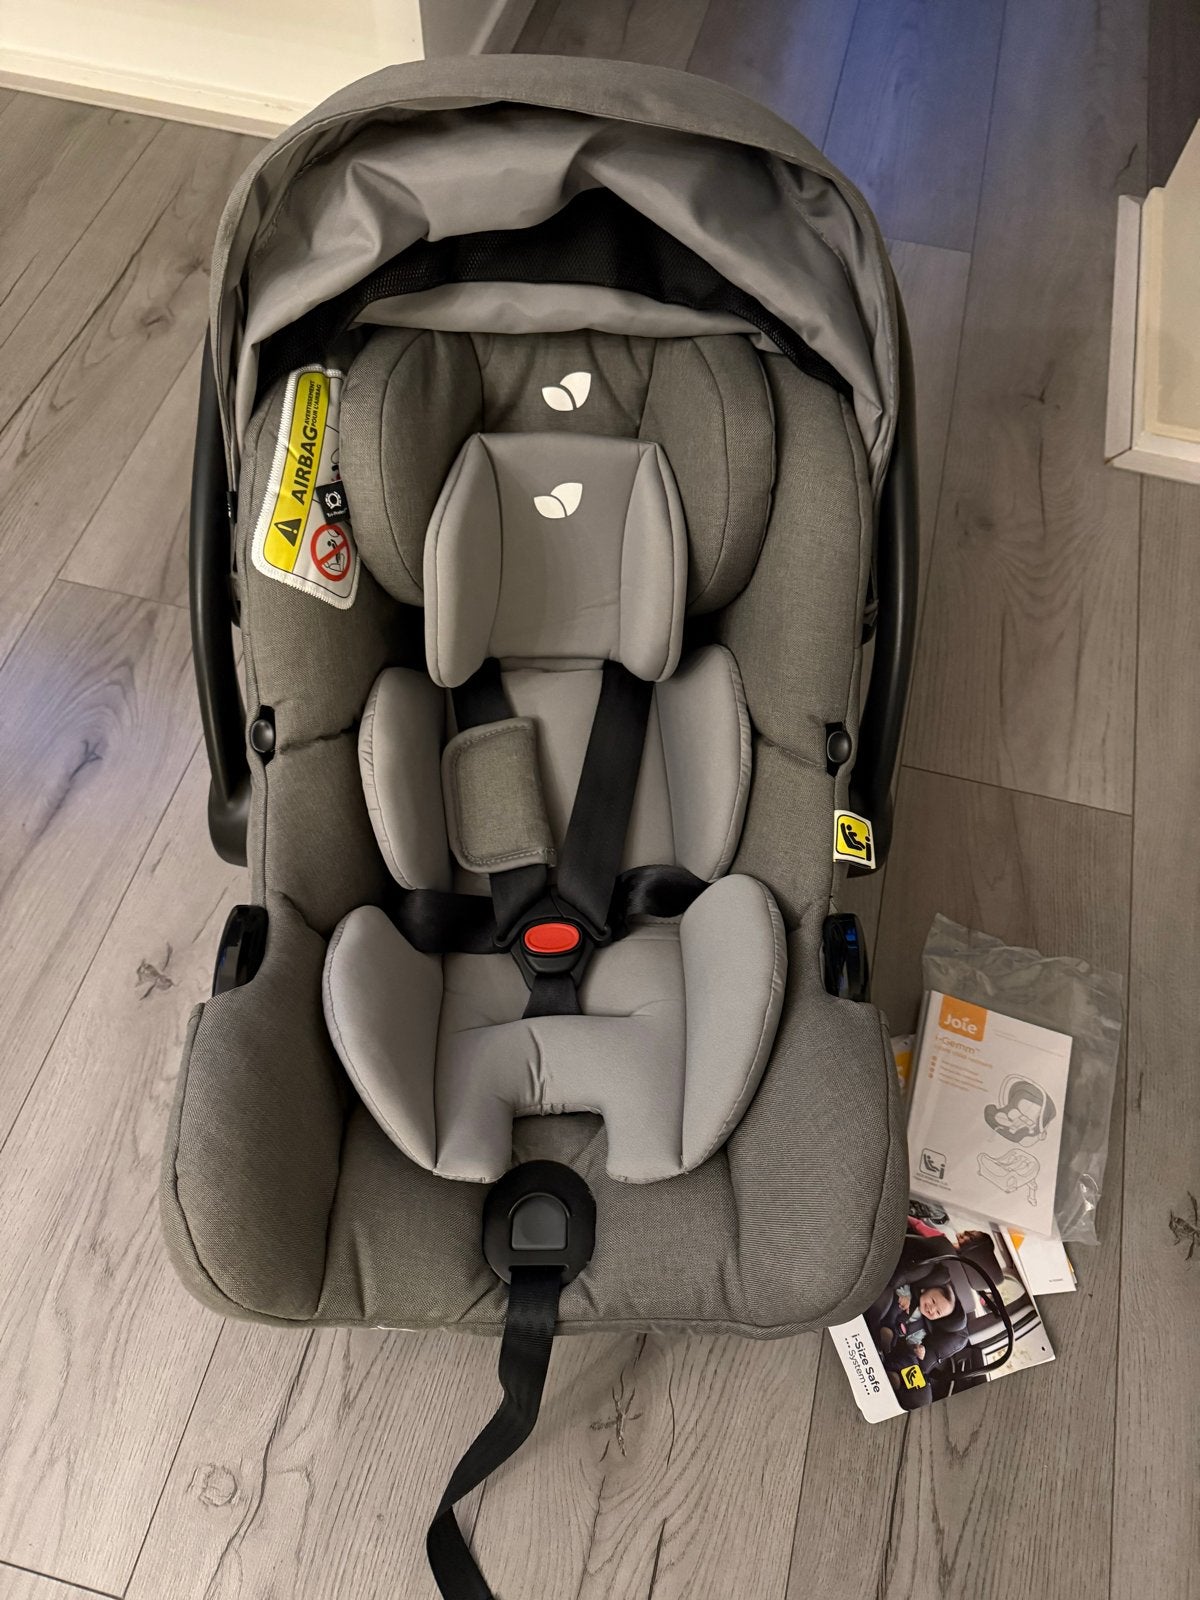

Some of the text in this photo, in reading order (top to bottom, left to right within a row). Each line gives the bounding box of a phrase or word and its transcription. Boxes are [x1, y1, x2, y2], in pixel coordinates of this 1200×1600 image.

[304, 380, 315, 426] AVERTISSEMENT
[291, 425, 318, 506] AIRBAG
[943, 1014, 978, 1034] Joie
[848, 1349, 866, 1384] System
[851, 1333, 880, 1393] i-Size Safe
